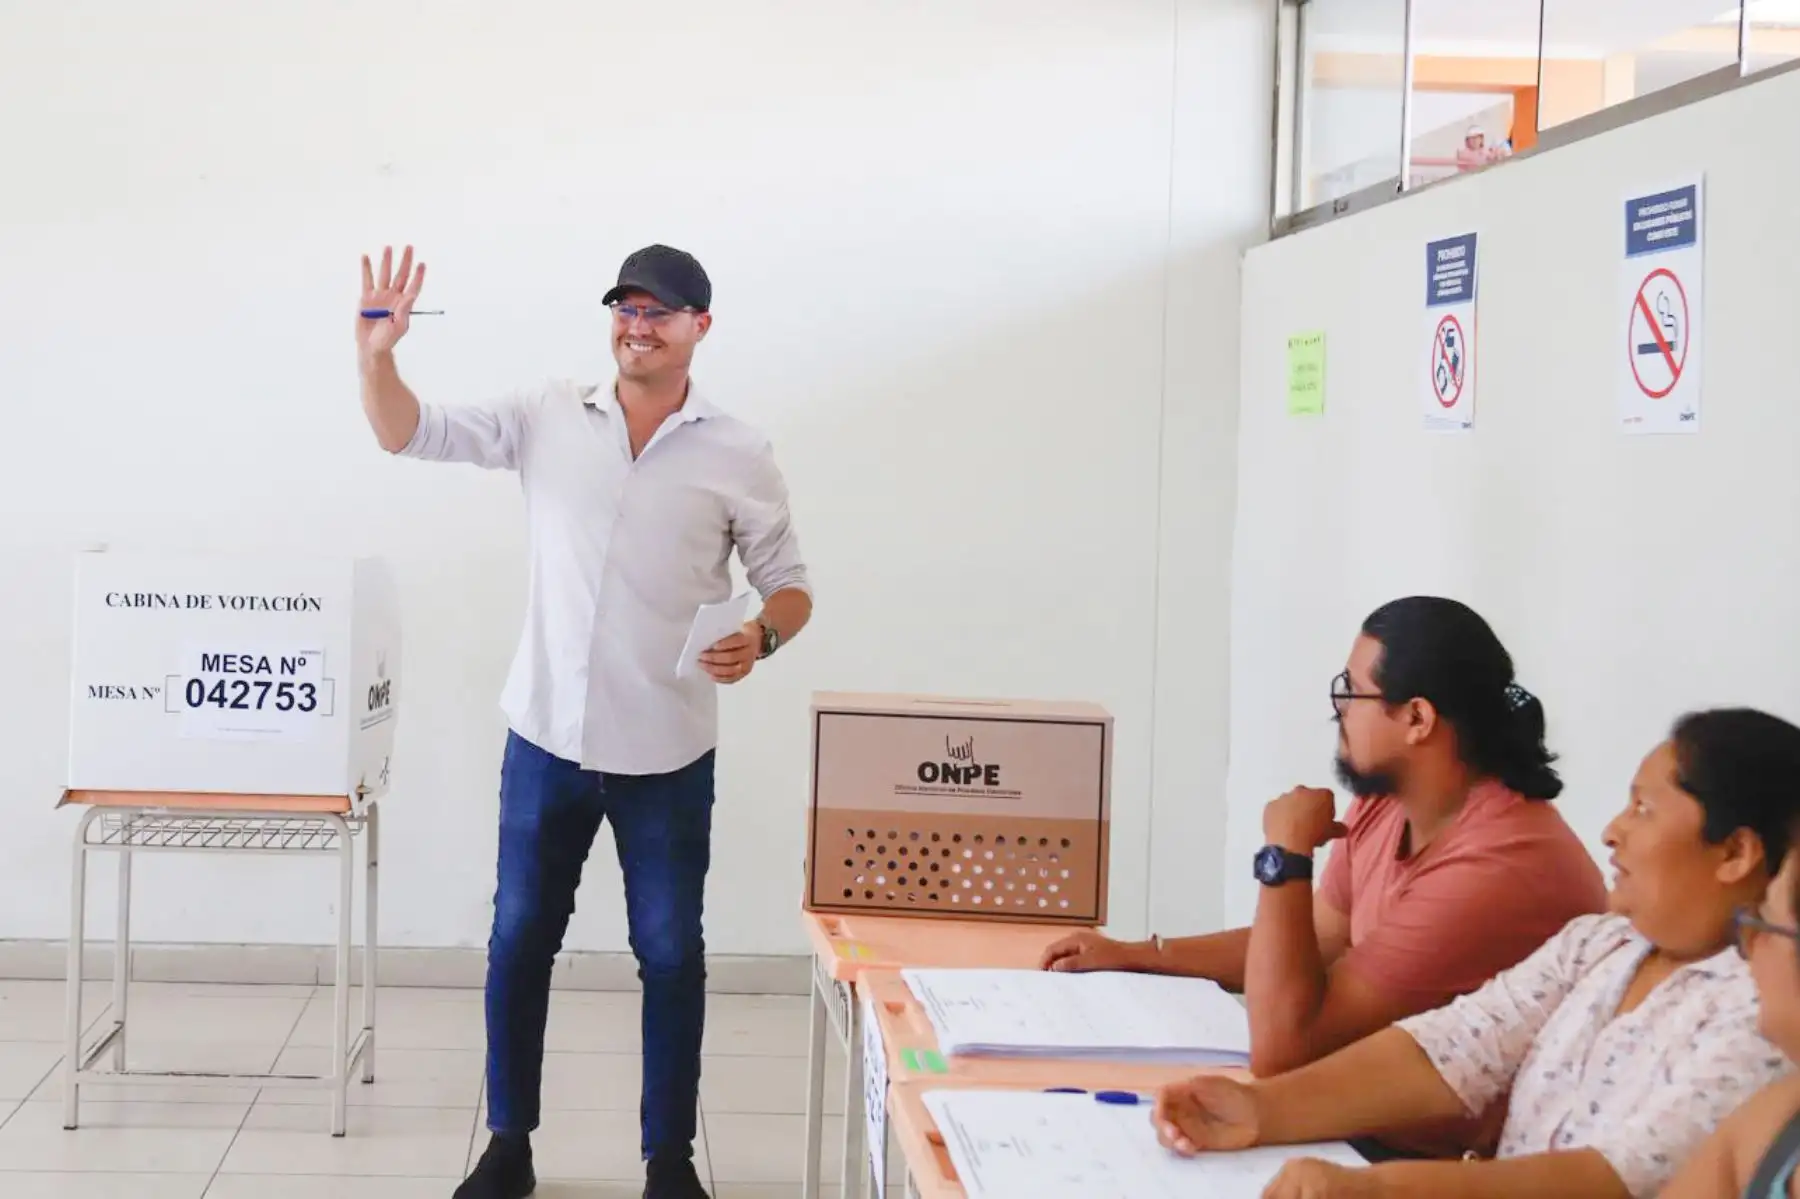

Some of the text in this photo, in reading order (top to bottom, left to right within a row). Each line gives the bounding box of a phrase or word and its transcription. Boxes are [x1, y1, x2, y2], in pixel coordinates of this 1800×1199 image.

[105, 592, 322, 612] CABINA DE VOTACIÓN
[201, 653, 272, 675] MESA
[88, 684, 137, 700] MESA
[185, 678, 318, 712] 042753
[917, 761, 1001, 786] ONPE
